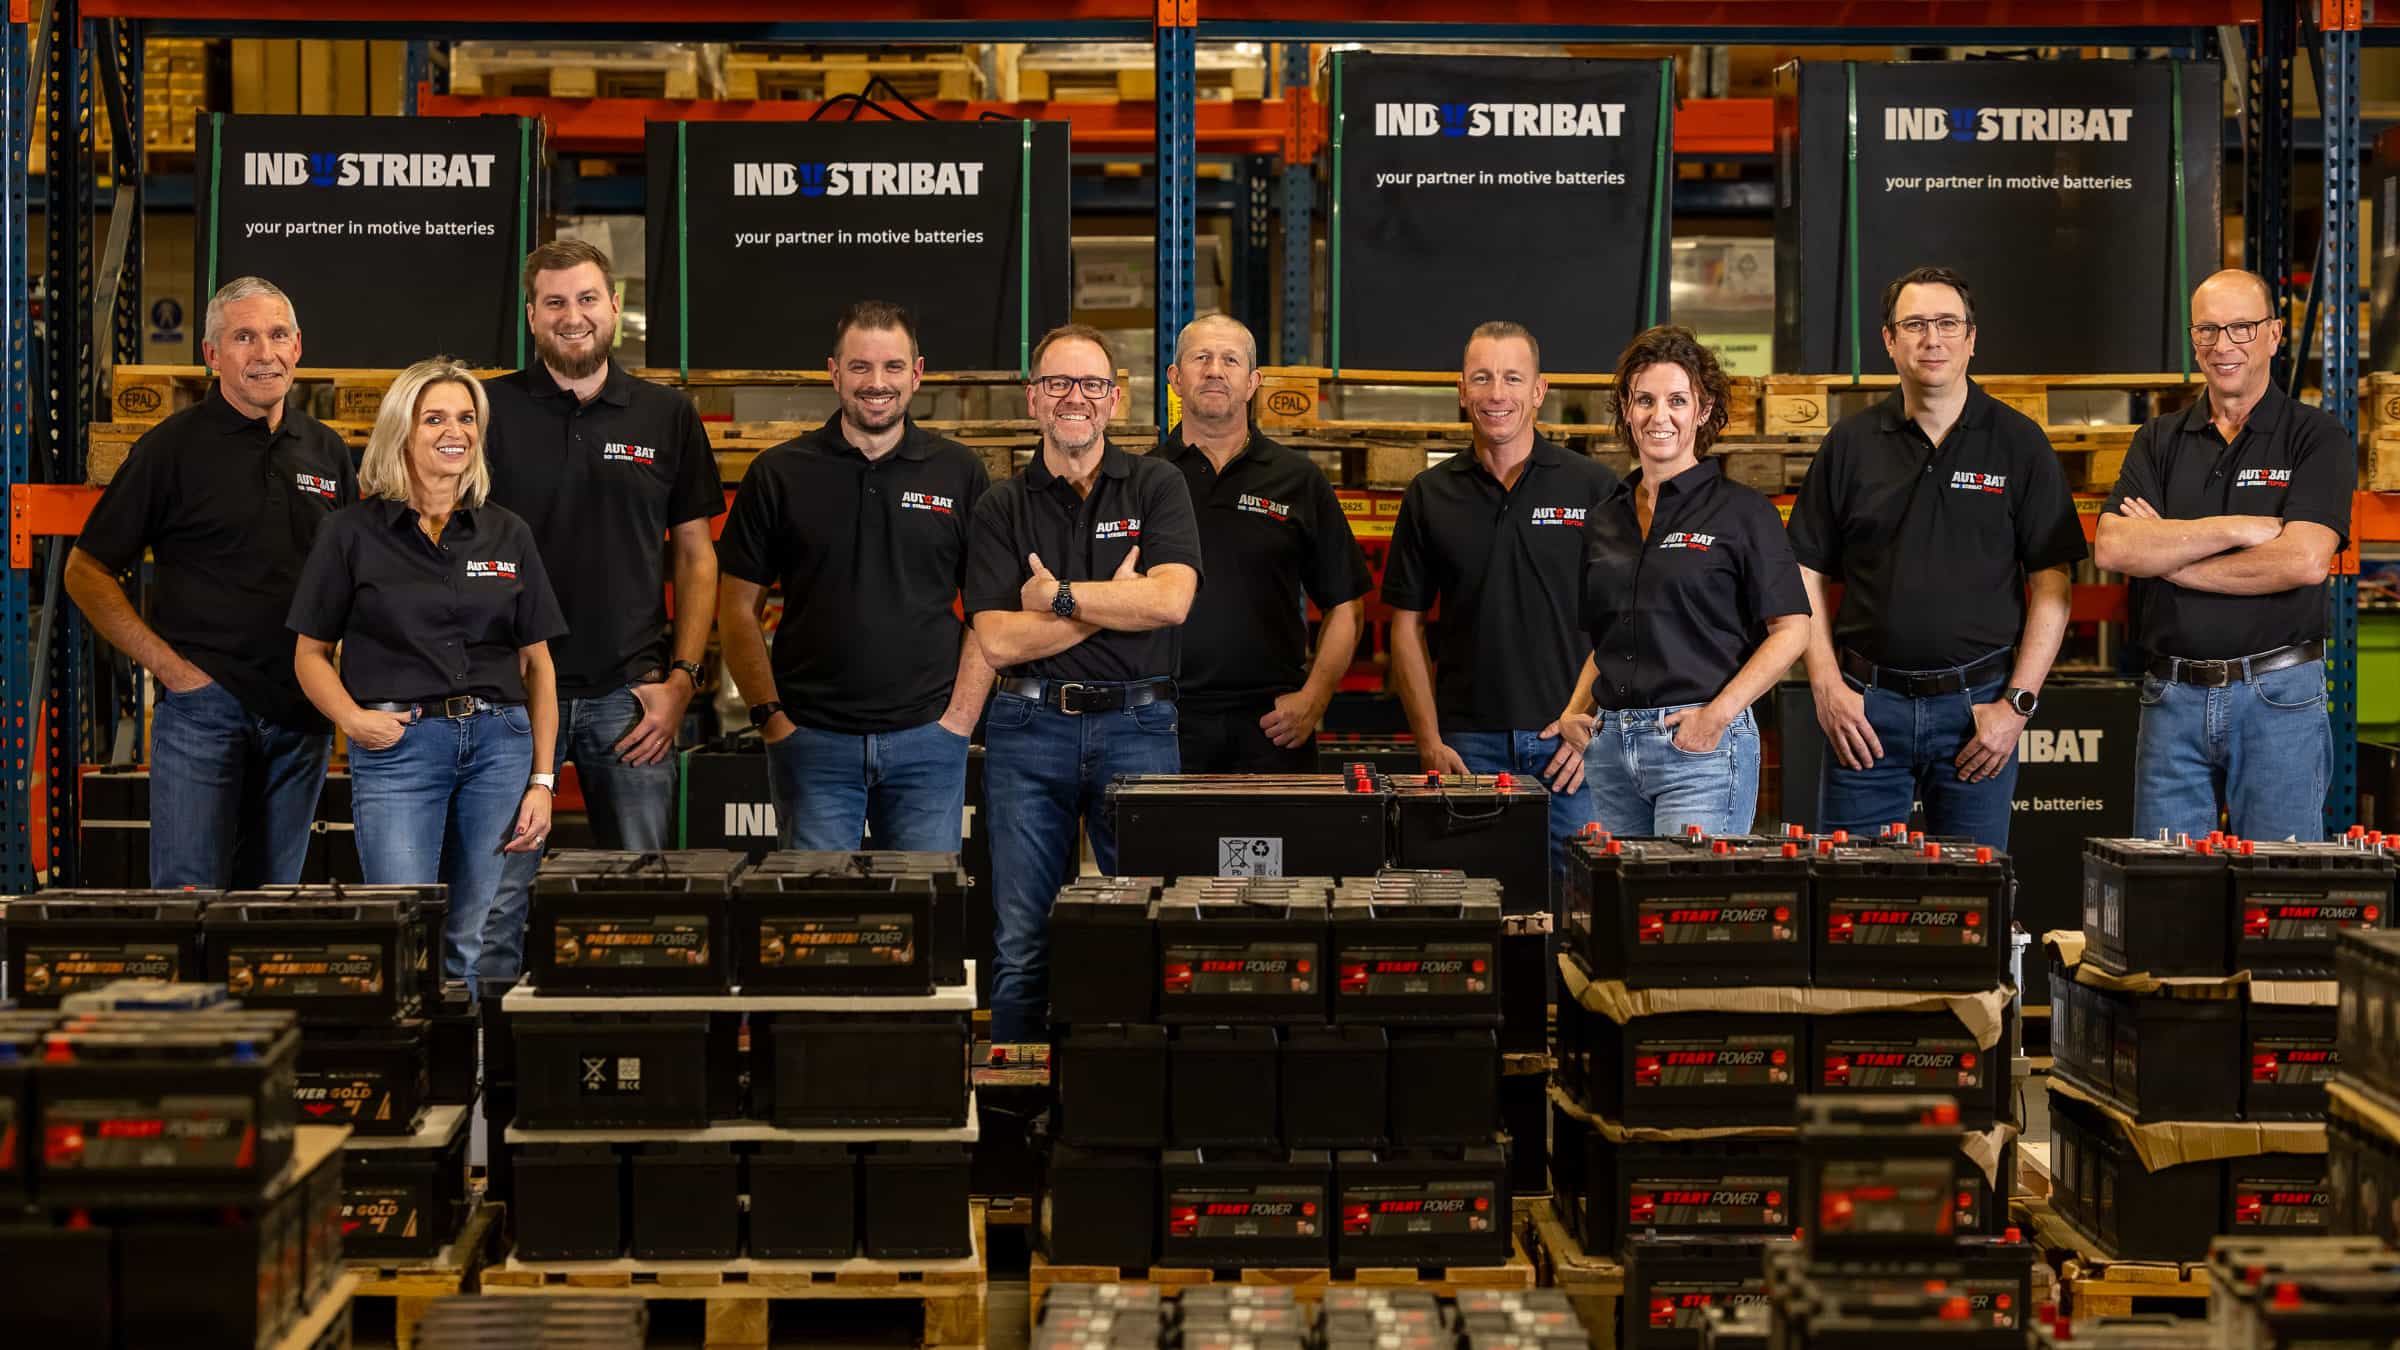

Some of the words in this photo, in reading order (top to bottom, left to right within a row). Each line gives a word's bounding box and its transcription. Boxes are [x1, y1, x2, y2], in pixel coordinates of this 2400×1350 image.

[1376, 103, 1625, 137] INDUSTRIBAT
[1885, 108, 2132, 142] INDUSTRIBAT
[244, 152, 496, 188] INDUSTRIBAT
[733, 162, 983, 196] INDUSTRIBAT
[1376, 173, 1414, 188] your
[1416, 171, 1476, 188] partner
[1479, 170, 1494, 184] in
[1497, 170, 1552, 184] motive
[1555, 170, 1625, 185] batteries
[1885, 178, 1923, 192] your
[1925, 176, 1985, 192] partner
[1987, 175, 2002, 188] in
[2006, 175, 2060, 188] motive
[2063, 175, 2133, 189] batteries
[245, 222, 282, 238] your
[285, 221, 345, 238] partner
[348, 220, 363, 234] in
[367, 220, 422, 234] motive
[425, 220, 495, 235] batteries
[735, 232, 772, 248] your
[775, 231, 835, 247] partner
[838, 229, 853, 243] in
[856, 229, 911, 243] motive
[914, 228, 984, 243] batteries
[124, 390, 155, 409] EPAL
[1273, 395, 1305, 411] EPAL
[604, 442, 656, 459] AUTOBAT
[1951, 471, 2007, 488] AUTOBAT
[2238, 469, 2292, 481] AUTOBAT
[902, 491, 954, 508] AUTOBAT
[1239, 494, 1289, 515] AUTOBAT
[1532, 507, 1587, 520] AUTOBAT
[1663, 532, 1716, 547] AUTOBAT
[466, 560, 516, 573] AUTOBAT
[2034, 796, 2104, 811] batteries
[1670, 909, 1720, 923] START
[1720, 909, 1767, 922] POWER
[1860, 911, 1909, 925] START
[1910, 912, 1958, 925] POWER
[2279, 907, 2319, 919] START
[2320, 907, 2357, 919] POWER
[585, 932, 655, 945] PREMIUM
[654, 933, 697, 945] POWER
[790, 932, 859, 945] PREMIUM
[861, 932, 903, 944] POWER
[1201, 960, 1245, 973] START
[1246, 961, 1287, 973] POWER
[1376, 961, 1418, 973] START
[1421, 961, 1463, 974] POWER
[1667, 1051, 1716, 1065] START
[1717, 1051, 1764, 1065] POWER
[1856, 1053, 1905, 1067] START
[1906, 1053, 1954, 1067] POWER
[2287, 1051, 2329, 1062] START
[330, 1087, 373, 1099] GOLD
[1661, 1191, 1712, 1205] START
[1712, 1192, 1759, 1206] POWER
[2271, 1193, 2312, 1204] START
[356, 1205, 399, 1216] GOLD
[1206, 1202, 1250, 1216] START
[1251, 1202, 1292, 1216] POWER
[1380, 1200, 1422, 1213] START
[1423, 1199, 1465, 1212] POWER
